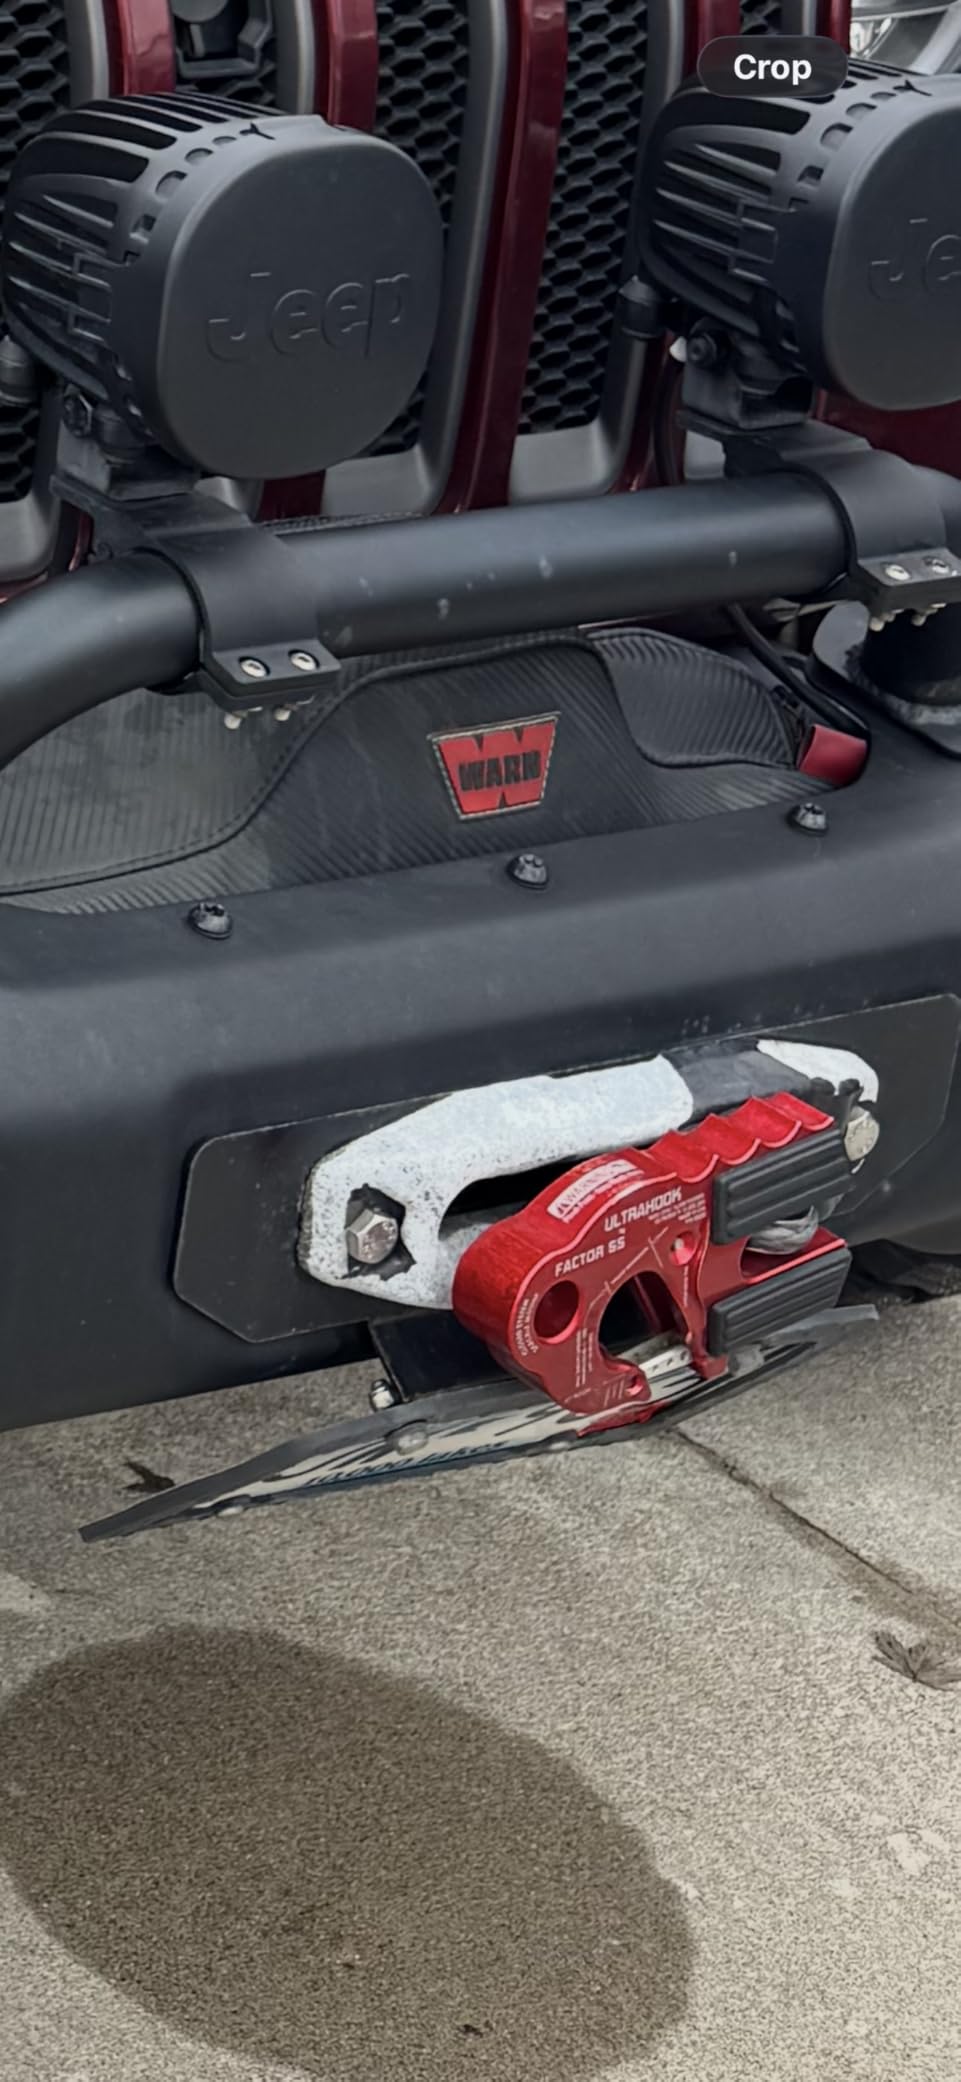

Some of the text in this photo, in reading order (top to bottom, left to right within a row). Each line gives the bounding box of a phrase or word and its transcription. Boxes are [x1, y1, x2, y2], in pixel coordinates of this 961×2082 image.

[206, 271, 411, 363] Jeep
[458, 750, 541, 792] WARN
[604, 1186, 682, 1232] ULTRAHOOK
[554, 1244, 605, 1278] FACTOR
